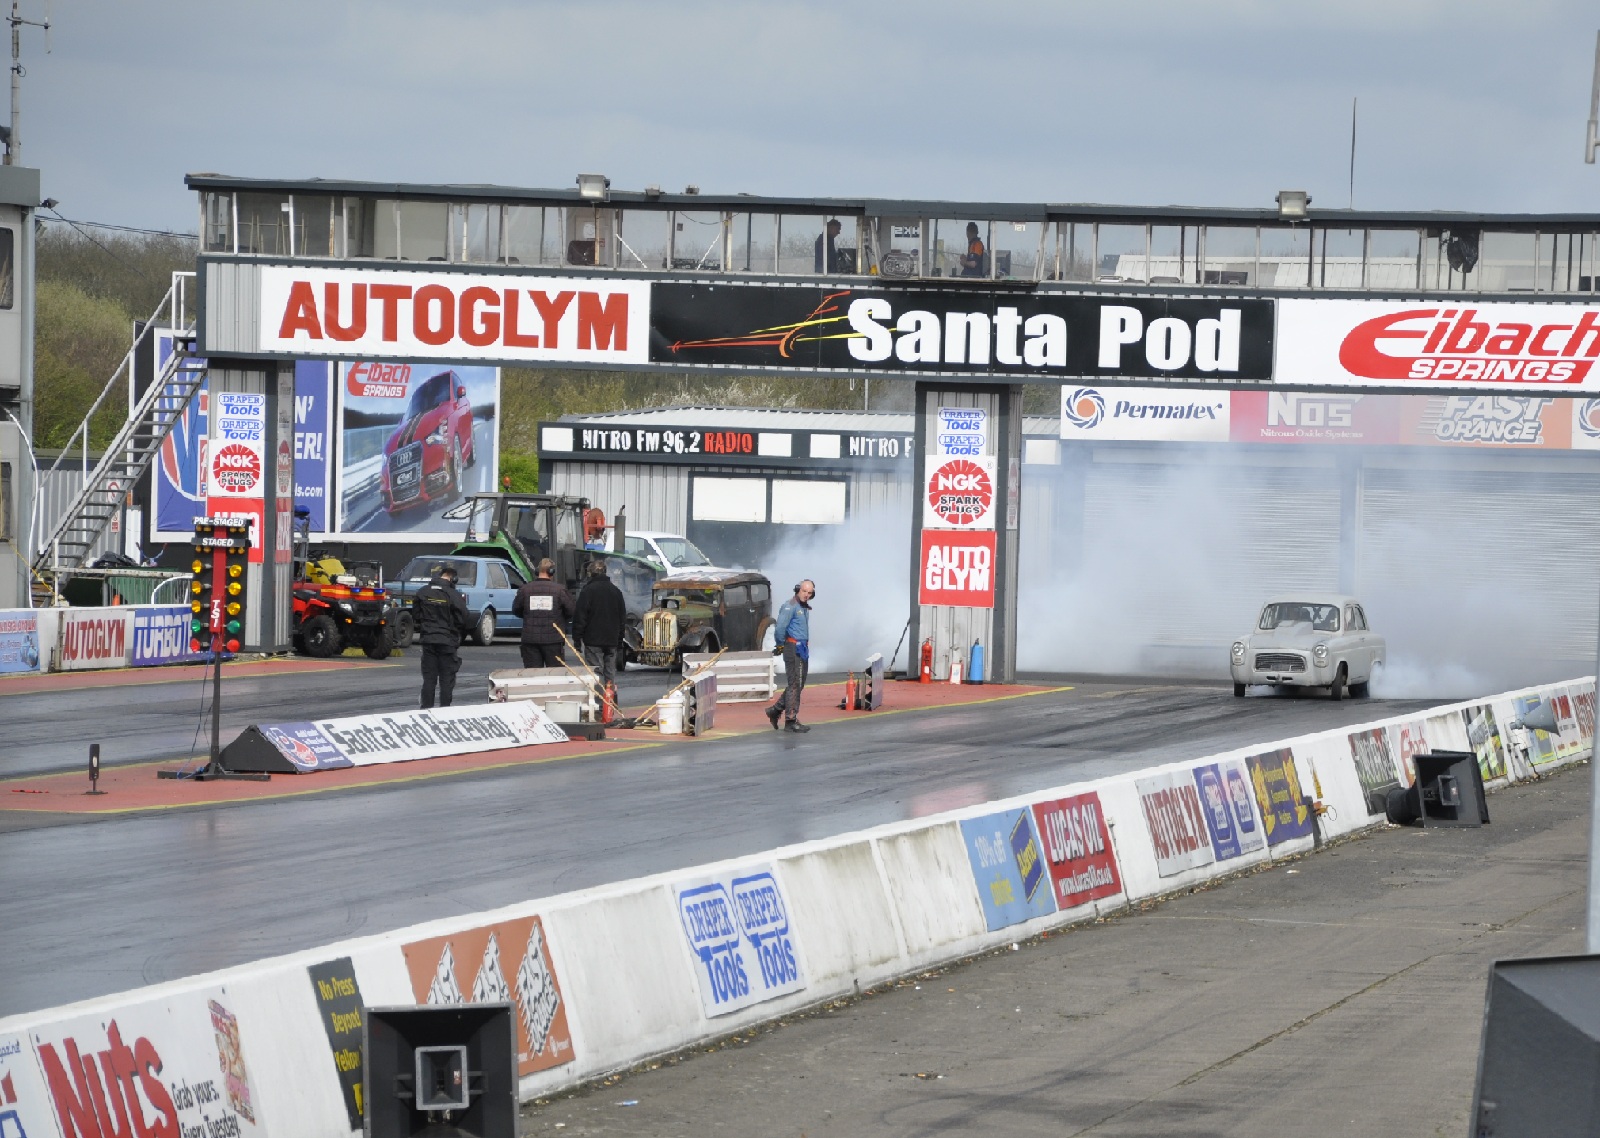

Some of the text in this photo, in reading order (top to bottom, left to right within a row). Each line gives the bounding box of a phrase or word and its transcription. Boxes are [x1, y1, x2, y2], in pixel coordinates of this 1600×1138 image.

[278, 280, 629, 351] AUTOGLYM
[846, 297, 1242, 373] Santa Pod
[1338, 308, 1600, 374] Eibach
[1407, 358, 1577, 381] SPRINGS
[221, 395, 260, 404] DRAPER
[362, 384, 403, 397] SPRINGS
[223, 403, 260, 415] Tools
[944, 409, 981, 419] DRAPER
[1113, 400, 1219, 420] Permatex
[1442, 395, 1553, 421] FAST
[221, 420, 260, 429] DRAPER
[223, 429, 260, 440] Tools
[944, 419, 980, 430] Tools
[1435, 418, 1542, 442] ORANGE
[582, 429, 631, 450] NITRO
[662, 430, 701, 454] 96.2
[704, 431, 754, 454] RADIO
[849, 436, 899, 458] NITRO
[943, 435, 980, 445] DRAPER
[944, 444, 980, 455] Tools
[219, 454, 254, 467] NGK
[221, 471, 252, 479] SPARK
[937, 473, 983, 490] NGK
[940, 496, 980, 505] SPARK
[940, 505, 980, 514] PLUGS
[193, 516, 244, 527] PRE-STAGED
[201, 537, 235, 547] STAGED
[926, 545, 991, 570] AUTO
[925, 568, 990, 592] GLYM
[62, 618, 126, 661] AUTOGLYM
[321, 723, 401, 755] Santa
[381, 713, 438, 749] Pod
[417, 712, 521, 745] Raceway
[1141, 784, 1210, 860] AUTOGLYM
[1043, 803, 1105, 864] LUCAS OIL
[685, 885, 784, 943] DRAPER DRAPER
[699, 926, 798, 1005] Tools Tools
[316, 976, 356, 1001] No Press
